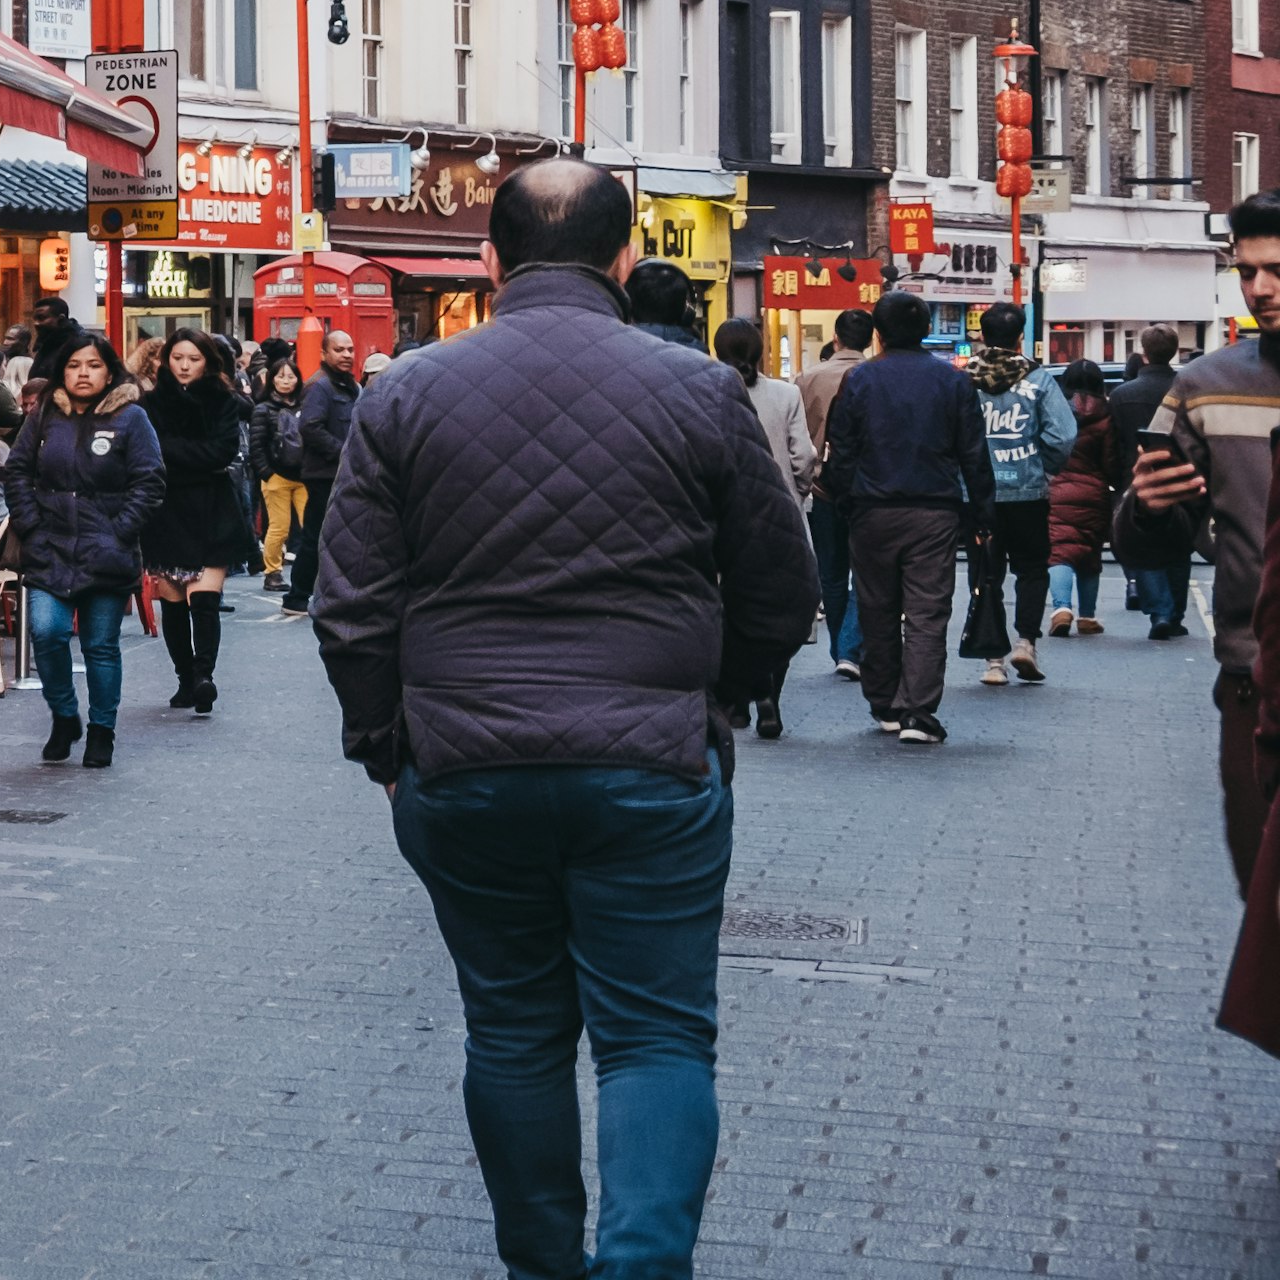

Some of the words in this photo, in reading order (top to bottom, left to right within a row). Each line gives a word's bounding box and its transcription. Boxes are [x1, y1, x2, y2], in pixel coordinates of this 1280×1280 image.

[34, 10, 58, 24] STREET
[95, 57, 168, 71] PEDESTRIAN
[105, 72, 157, 91] ZONE
[102, 168, 116, 179] No
[92, 185, 120, 196] Noon
[127, 183, 173, 196] Midnight
[131, 209, 143, 219] At
[146, 210, 165, 221] any
[191, 198, 262, 224] MEDICINE
[892, 208, 928, 220] KAYA
[994, 442, 1038, 463] WILL
